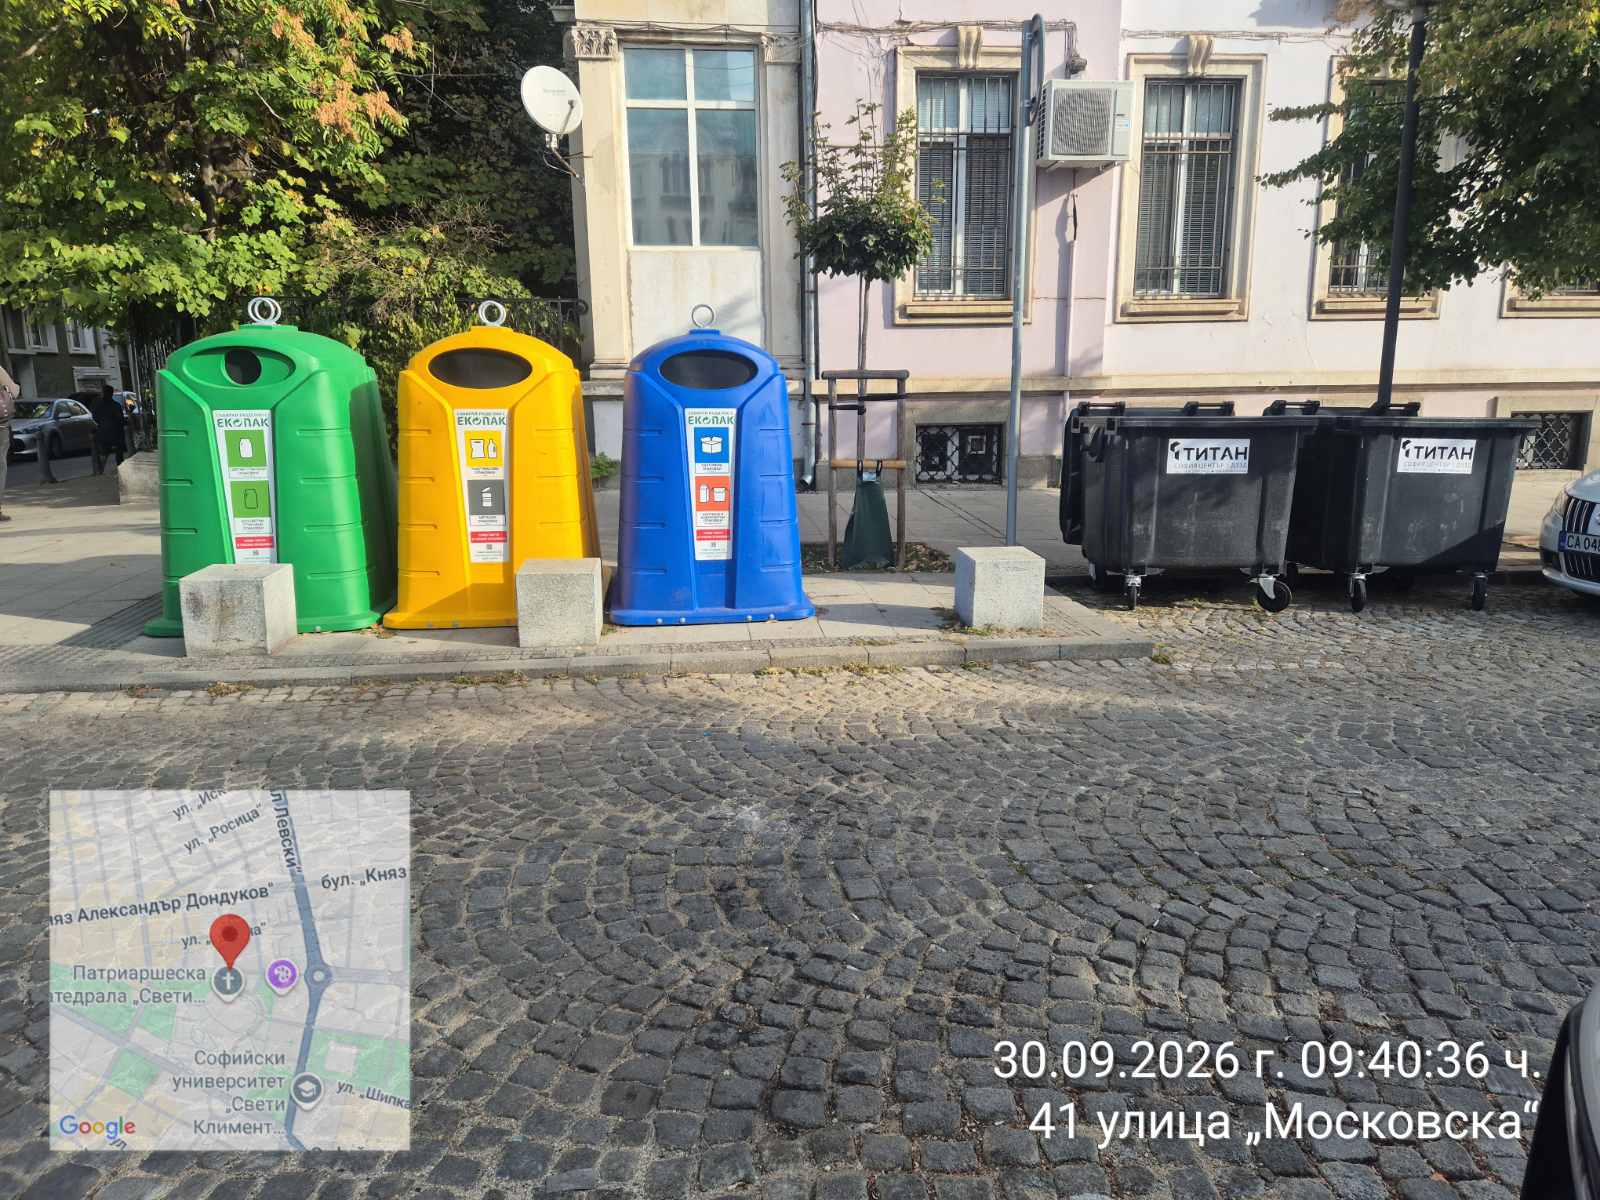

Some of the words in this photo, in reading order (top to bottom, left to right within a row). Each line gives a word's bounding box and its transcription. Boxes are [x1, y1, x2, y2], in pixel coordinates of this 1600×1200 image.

[457, 416, 506, 425] ЕКОПАК
[1183, 446, 1248, 461] ТИТАН
[1413, 446, 1473, 460] ТИТАН
